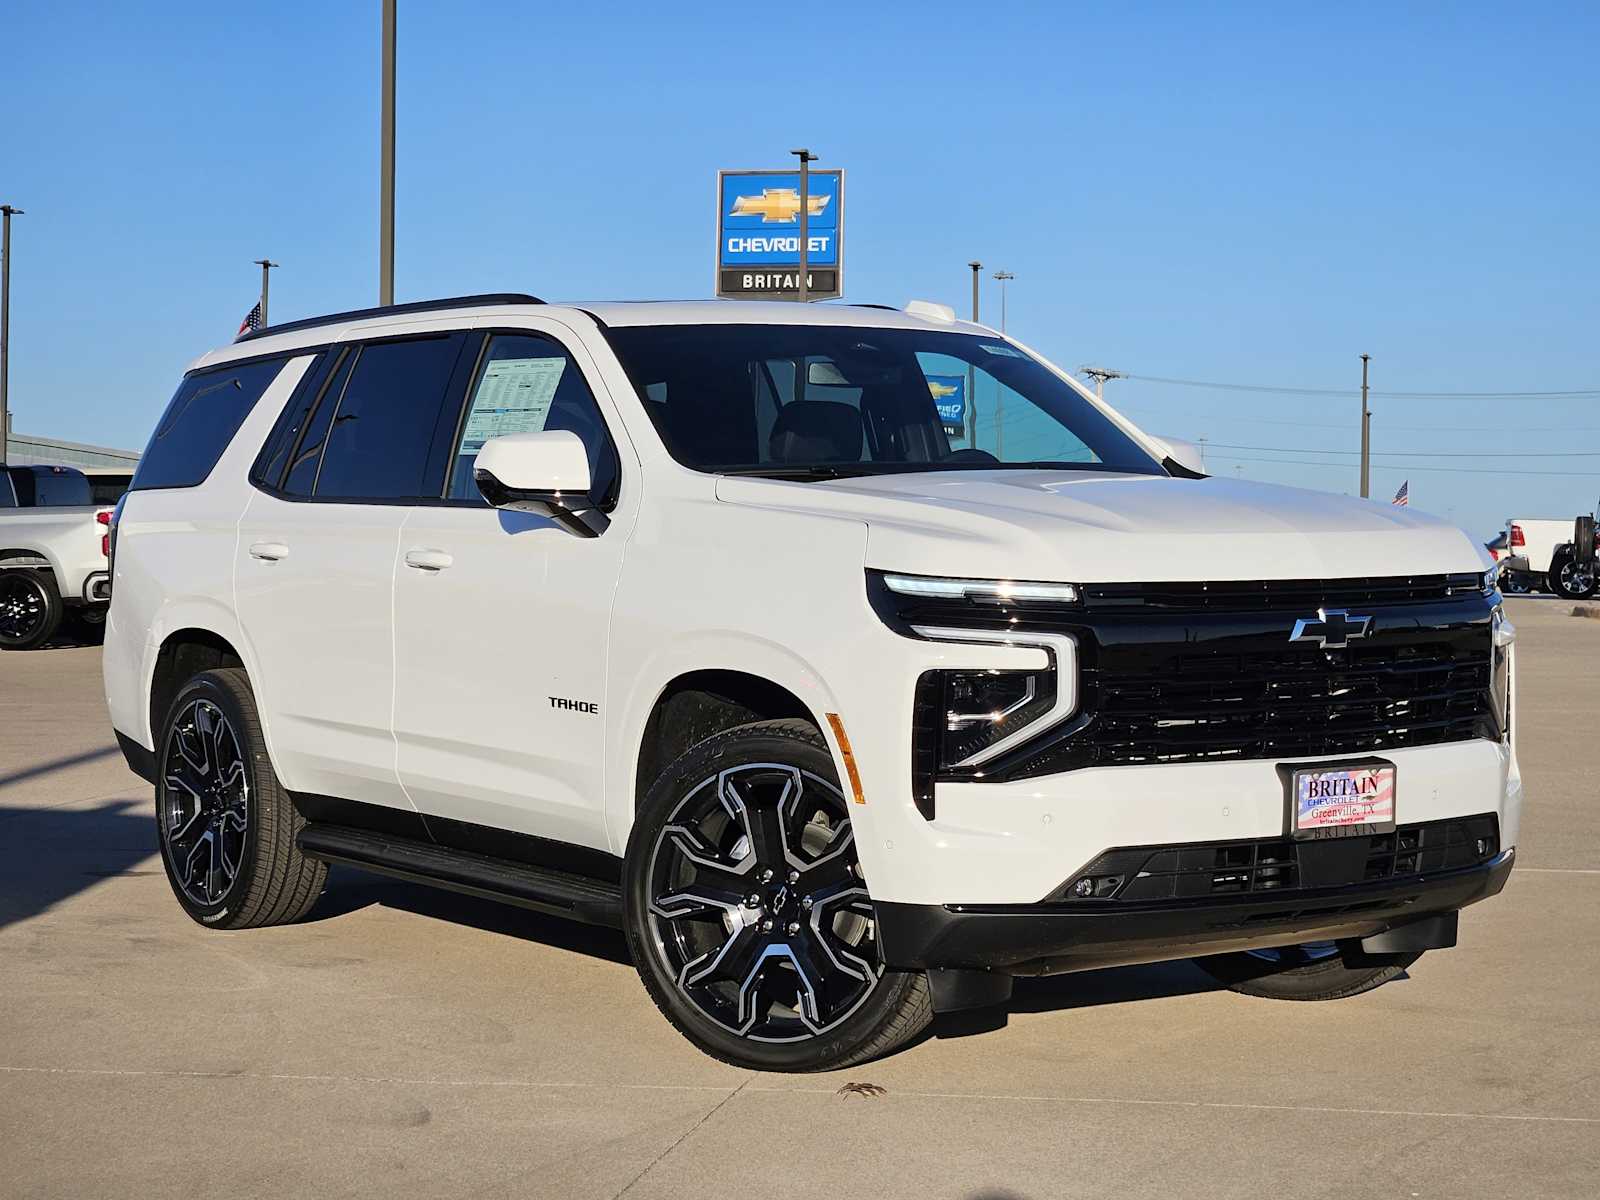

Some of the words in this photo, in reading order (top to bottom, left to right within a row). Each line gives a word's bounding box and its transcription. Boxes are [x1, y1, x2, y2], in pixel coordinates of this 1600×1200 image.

[548, 696, 598, 714] TAHOE
[1309, 777, 1378, 798] BRITAIN
[1307, 796, 1360, 807] CHEVROLET
[1361, 803, 1375, 815] TX
[1314, 824, 1377, 839] BRITAIN
